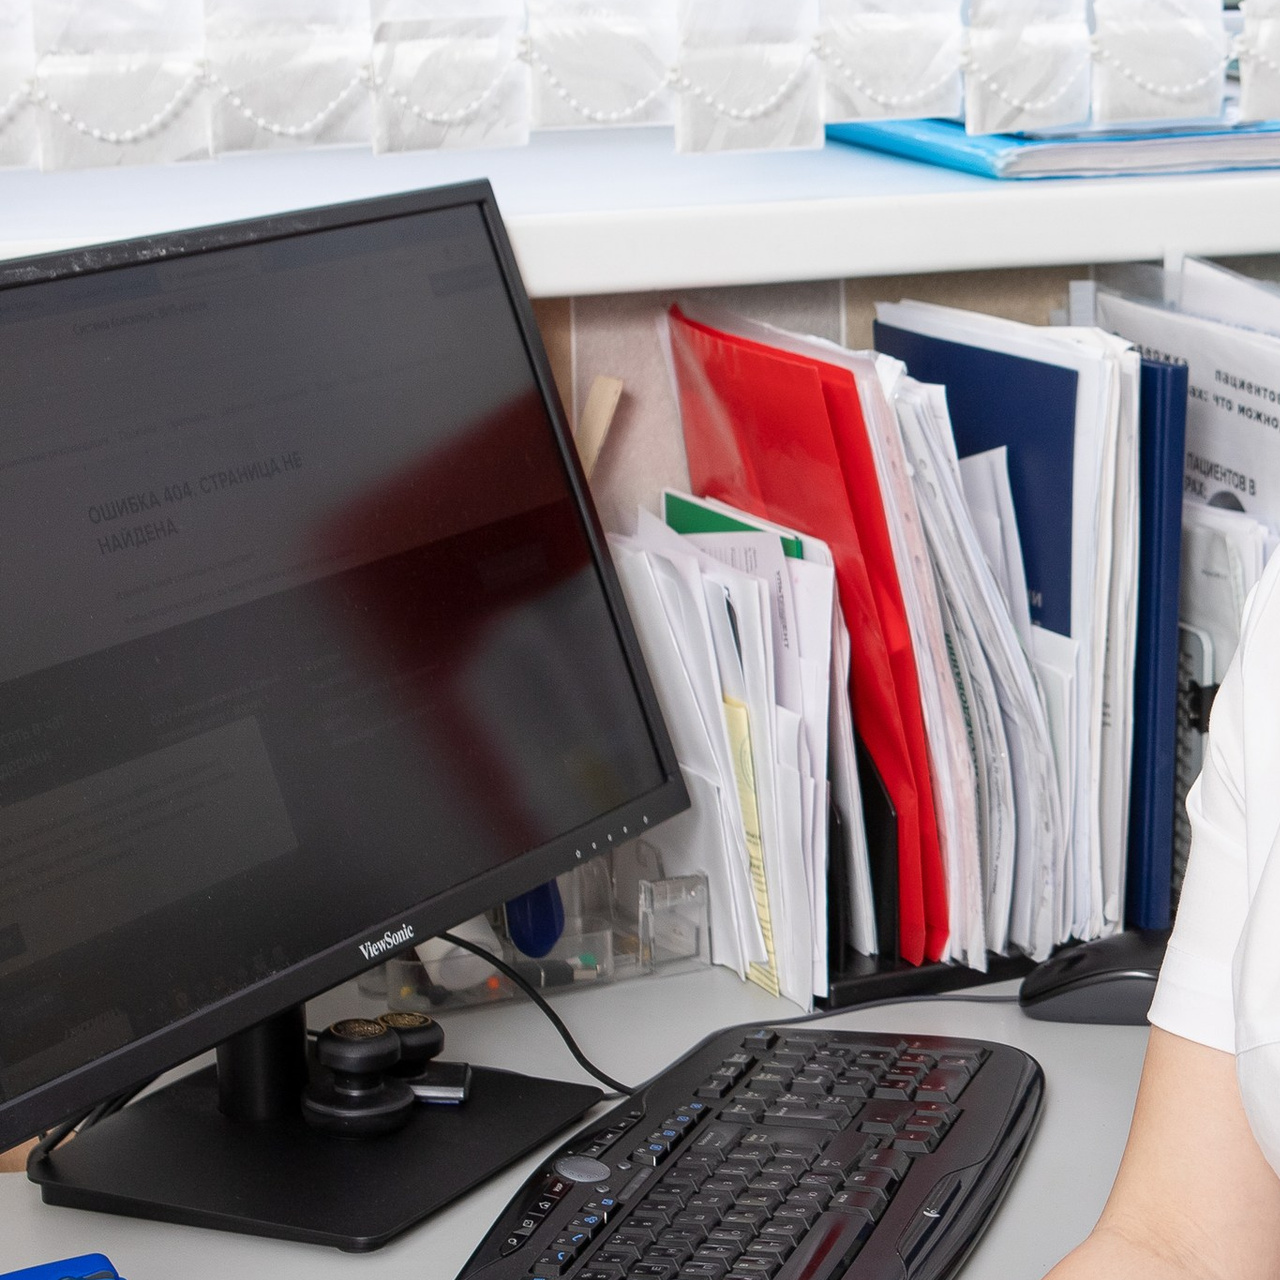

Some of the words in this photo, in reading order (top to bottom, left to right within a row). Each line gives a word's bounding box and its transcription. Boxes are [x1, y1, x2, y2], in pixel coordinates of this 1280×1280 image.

[1188, 385, 1208, 402] ах:
[1213, 394, 1232, 411] что
[87, 490, 162, 526] ОШИБКА
[199, 457, 282, 495] СТРАНИЦА
[281, 450, 303, 472] НЕ
[1186, 452, 1246, 491] ПАЦИЕНТОВ
[97, 517, 180, 557] НАЙДЕНА
[358, 923, 414, 960] ViewSonic
